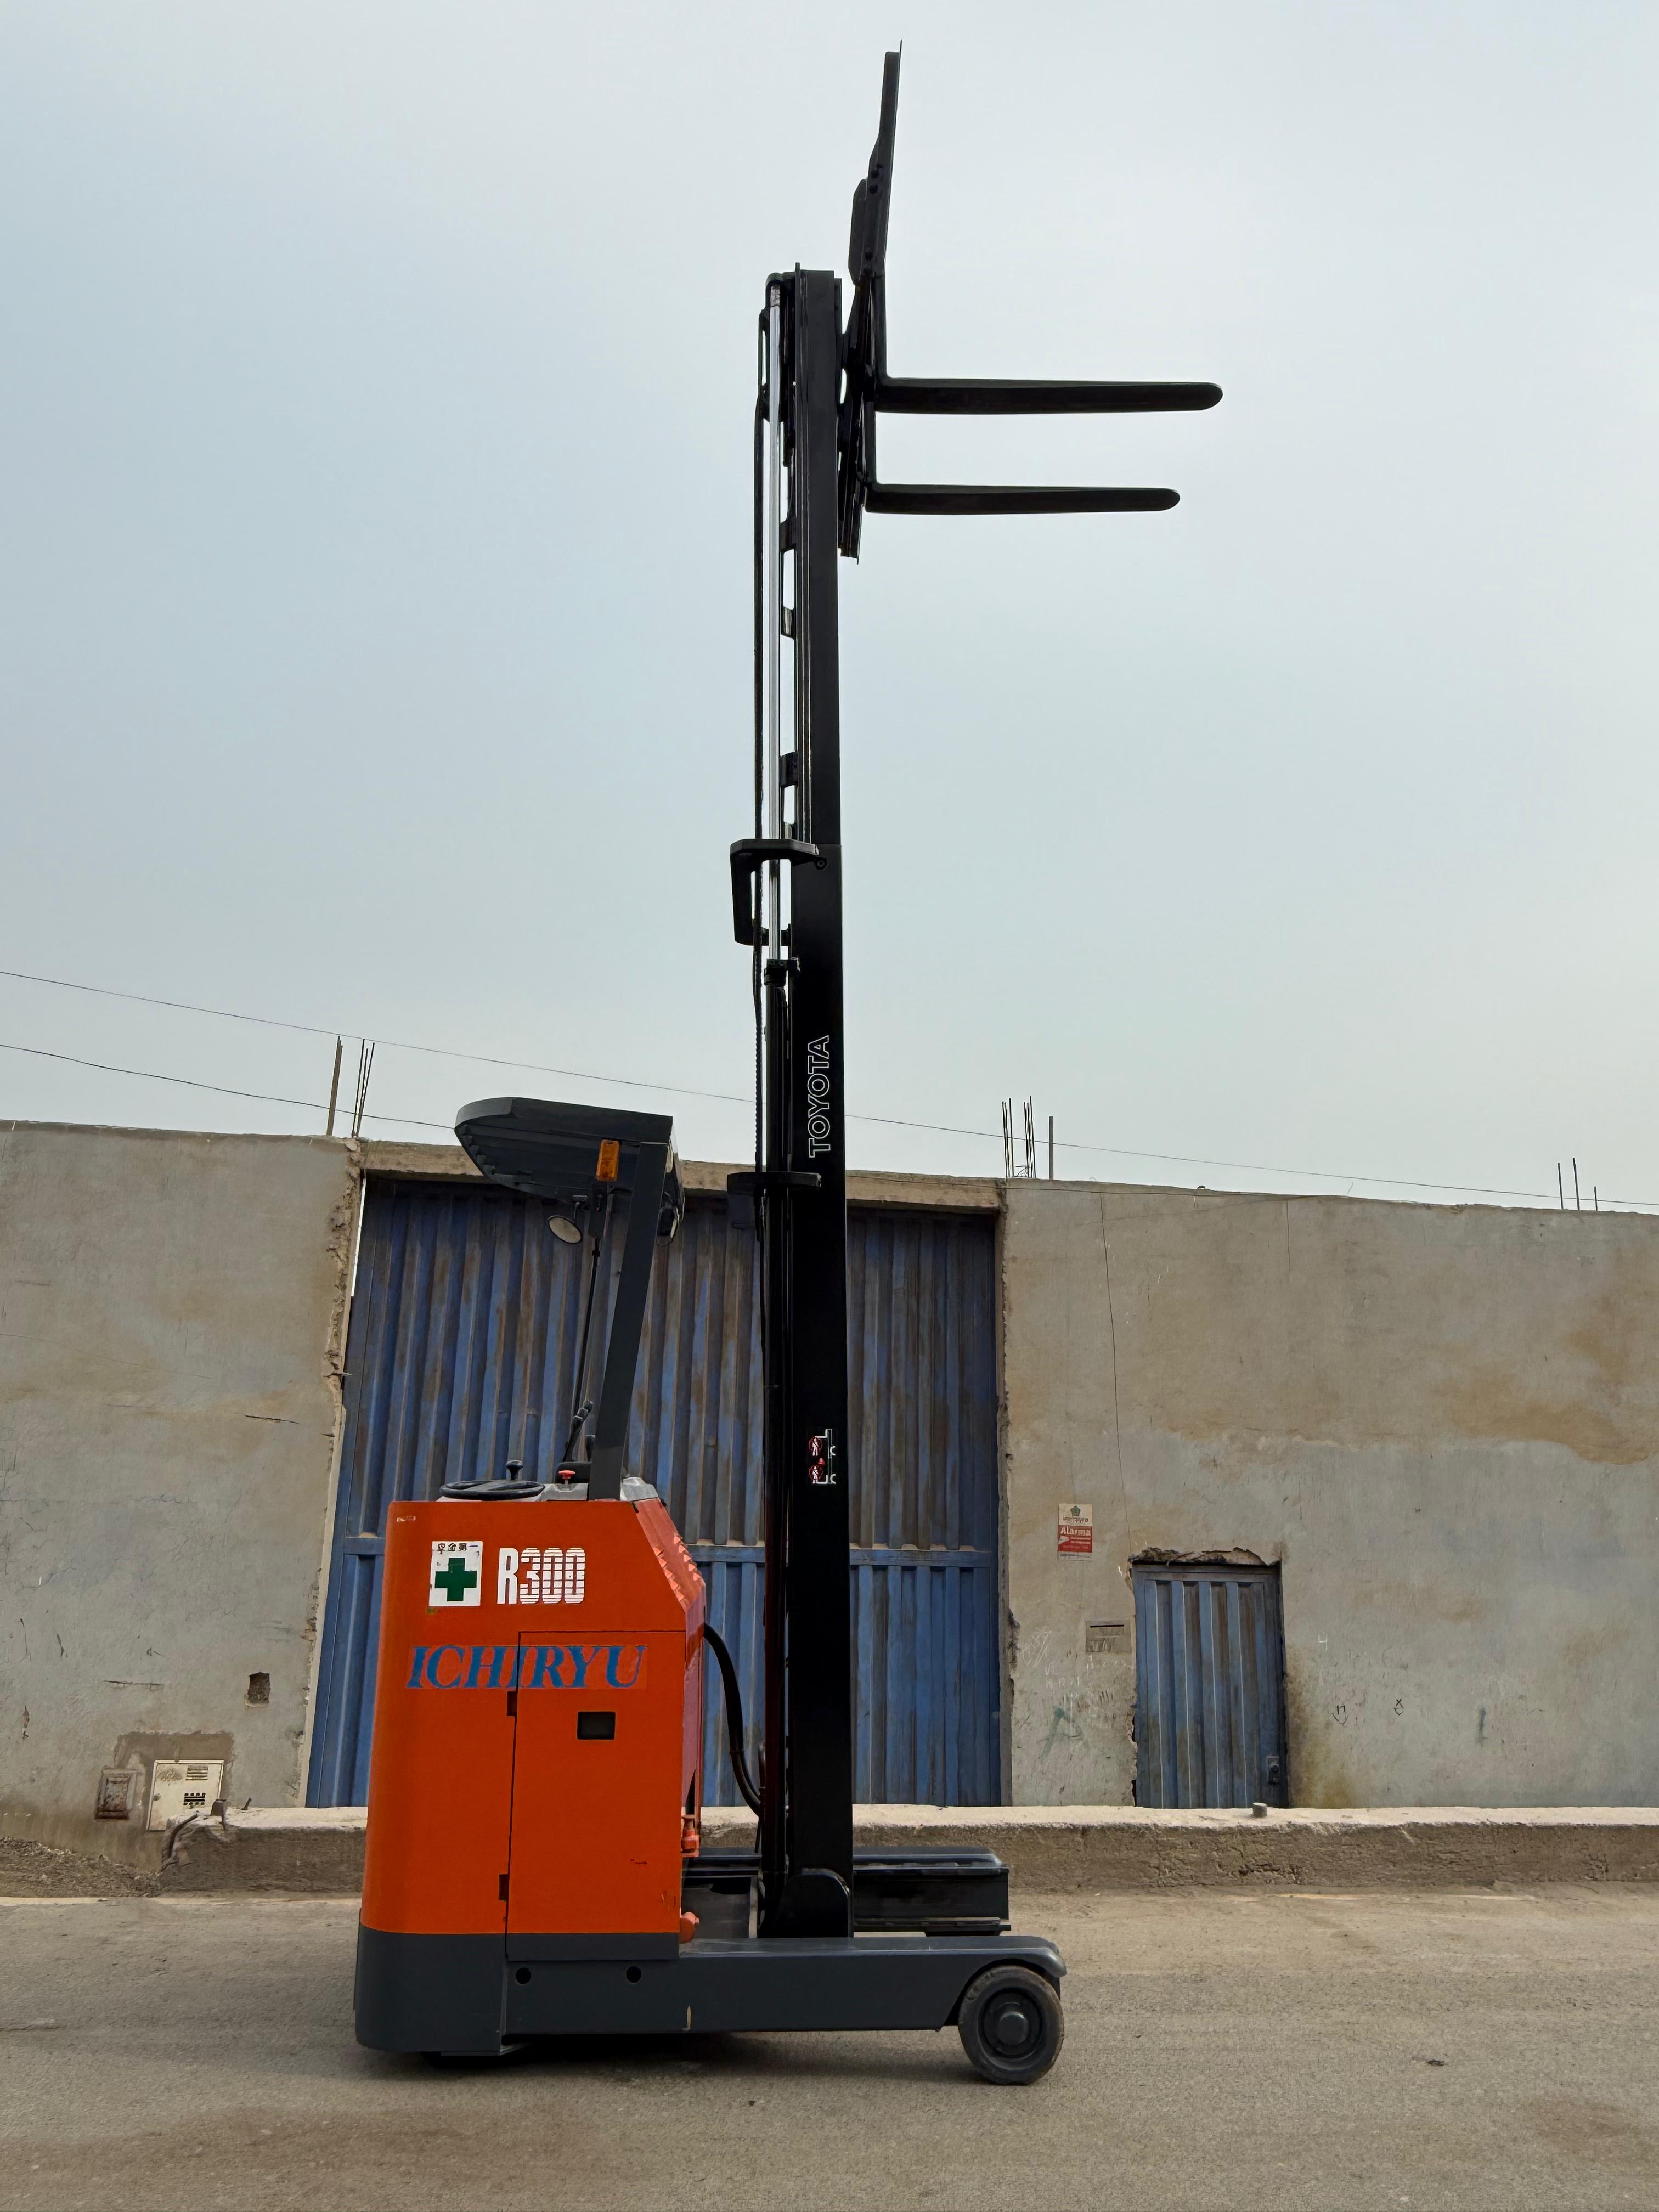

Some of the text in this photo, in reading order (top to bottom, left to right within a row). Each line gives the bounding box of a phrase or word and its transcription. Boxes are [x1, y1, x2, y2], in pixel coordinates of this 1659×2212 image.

[807, 1035, 831, 1158] TOYOTA
[497, 1547, 585, 1604] R300
[406, 1645, 647, 1689] ICHIRYU
